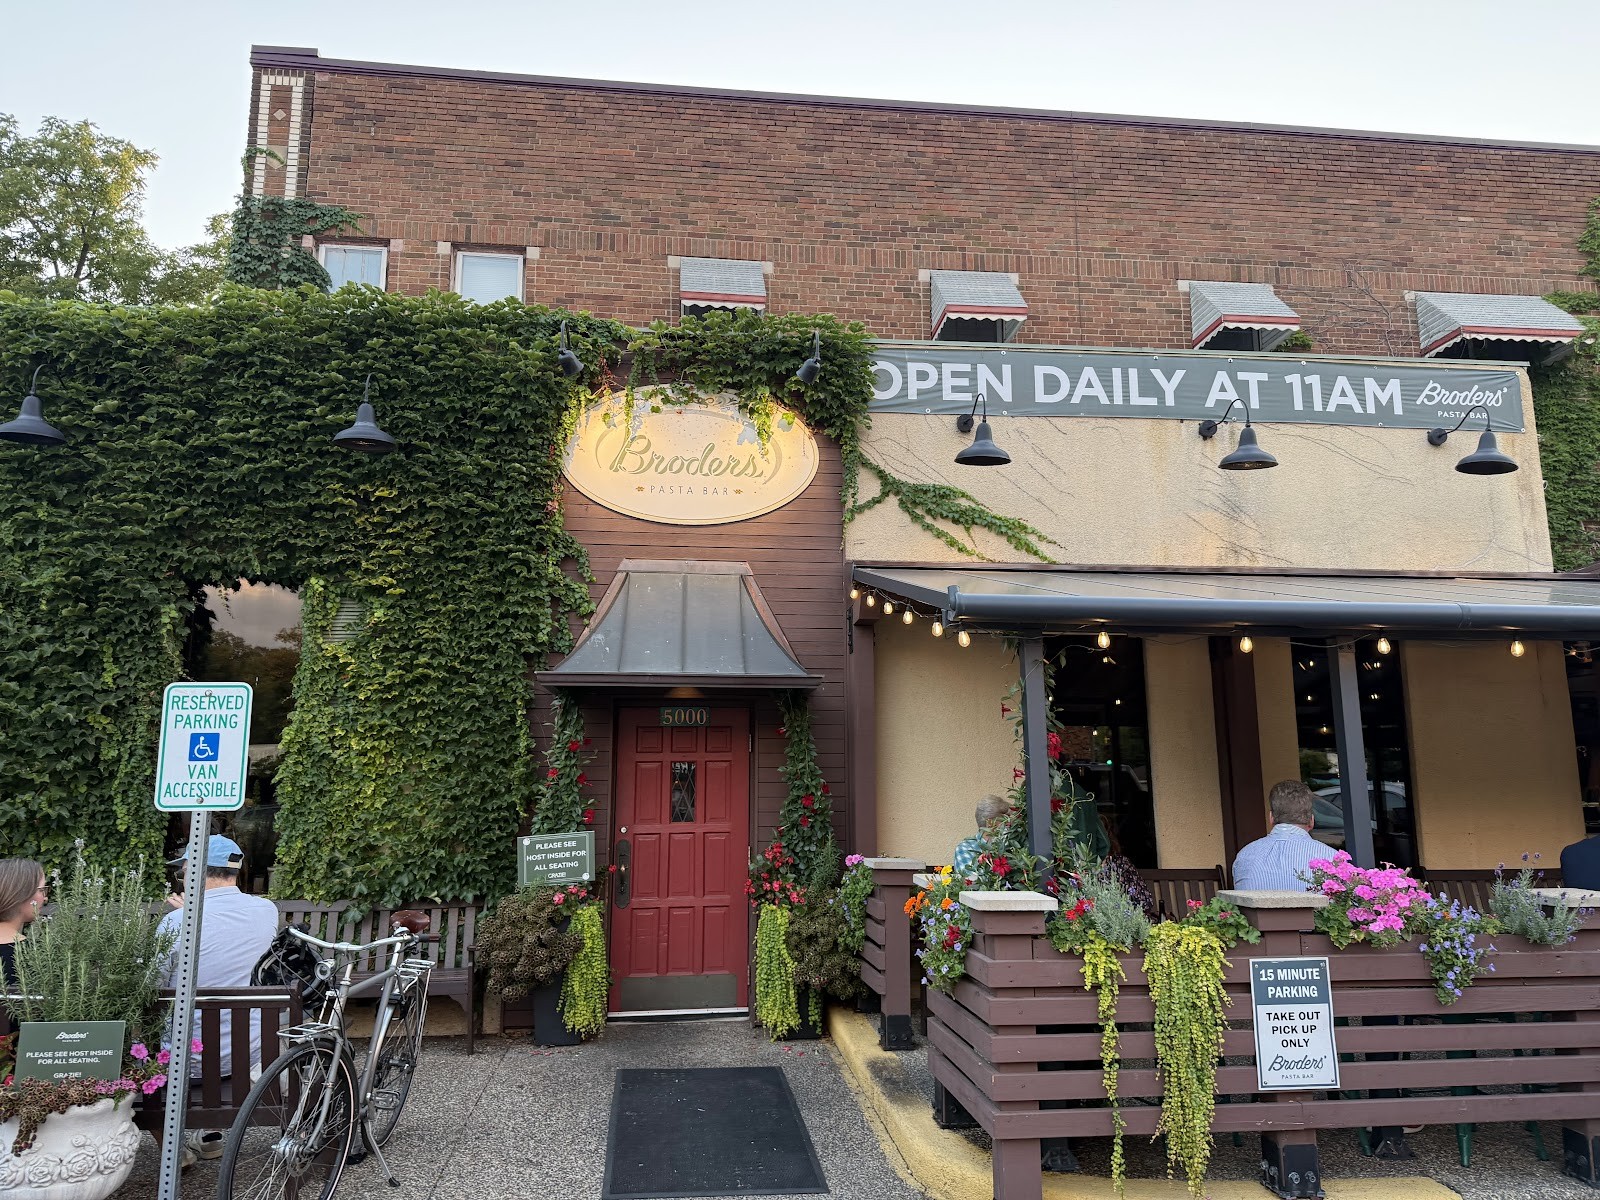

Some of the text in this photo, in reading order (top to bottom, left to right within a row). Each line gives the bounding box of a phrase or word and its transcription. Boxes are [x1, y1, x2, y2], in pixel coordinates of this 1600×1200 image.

[867, 360, 1403, 415] OPEN DAILY AT 11AM
[1416, 380, 1508, 407] Broders'
[650, 485, 729, 496] PASTA BAR
[171, 695, 244, 710] RESERVED
[174, 714, 238, 729] PARKING
[662, 708, 707, 725] 5000
[188, 764, 218, 779] VAN
[163, 782, 238, 798] ACCESSIBLE
[535, 842, 562, 850] PLEASE
[526, 853, 546, 861] HOST
[547, 851, 571, 859] INSIDE
[534, 861, 579, 871] ALL SEATING
[1259, 968, 1321, 981] 15 MINUTE
[1267, 985, 1318, 998] PARKING
[1266, 1011, 1321, 1021] TAKE OUT
[1271, 1025, 1317, 1034] PICK UP
[1281, 1038, 1310, 1048] ONLY
